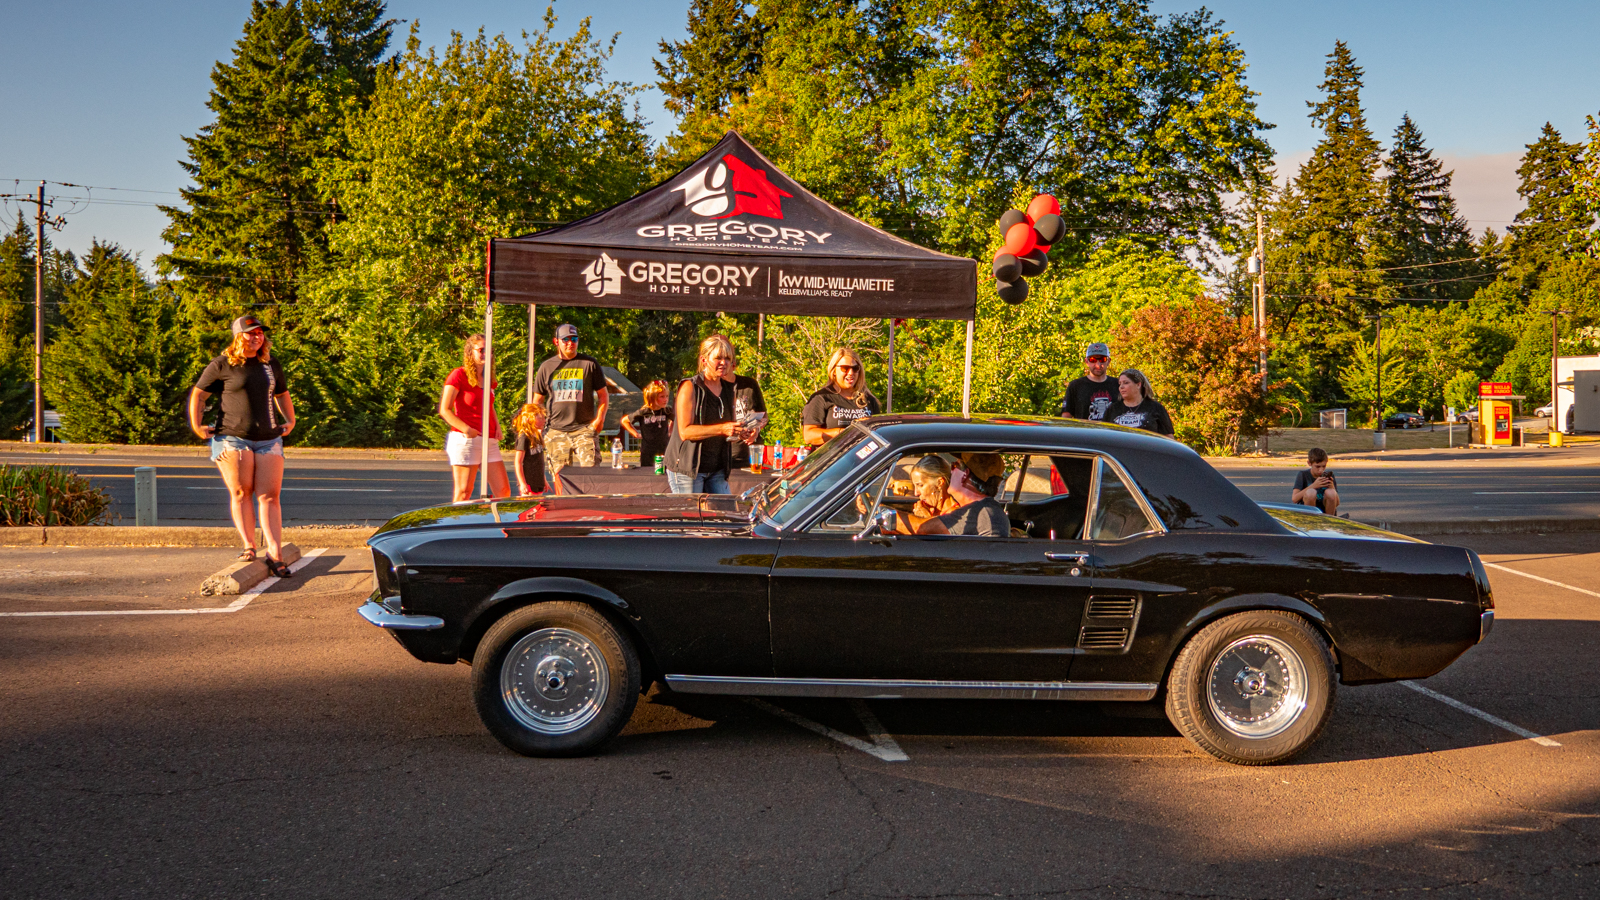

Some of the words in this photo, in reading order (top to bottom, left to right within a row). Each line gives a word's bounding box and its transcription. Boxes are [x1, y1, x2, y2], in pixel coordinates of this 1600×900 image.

[637, 220, 832, 244] GREGORY
[670, 234, 732, 242] HOME
[747, 235, 805, 246] TEAM
[628, 261, 759, 287] GREGORY
[778, 270, 803, 287] kw
[803, 276, 894, 292] MID-WILLAMETTE
[649, 285, 690, 294] HOME
[699, 286, 738, 296] TEAM
[830, 290, 853, 298] REALTY
[556, 370, 579, 379] WORK
[556, 380, 580, 389] REST
[557, 391, 580, 400] PLAY
